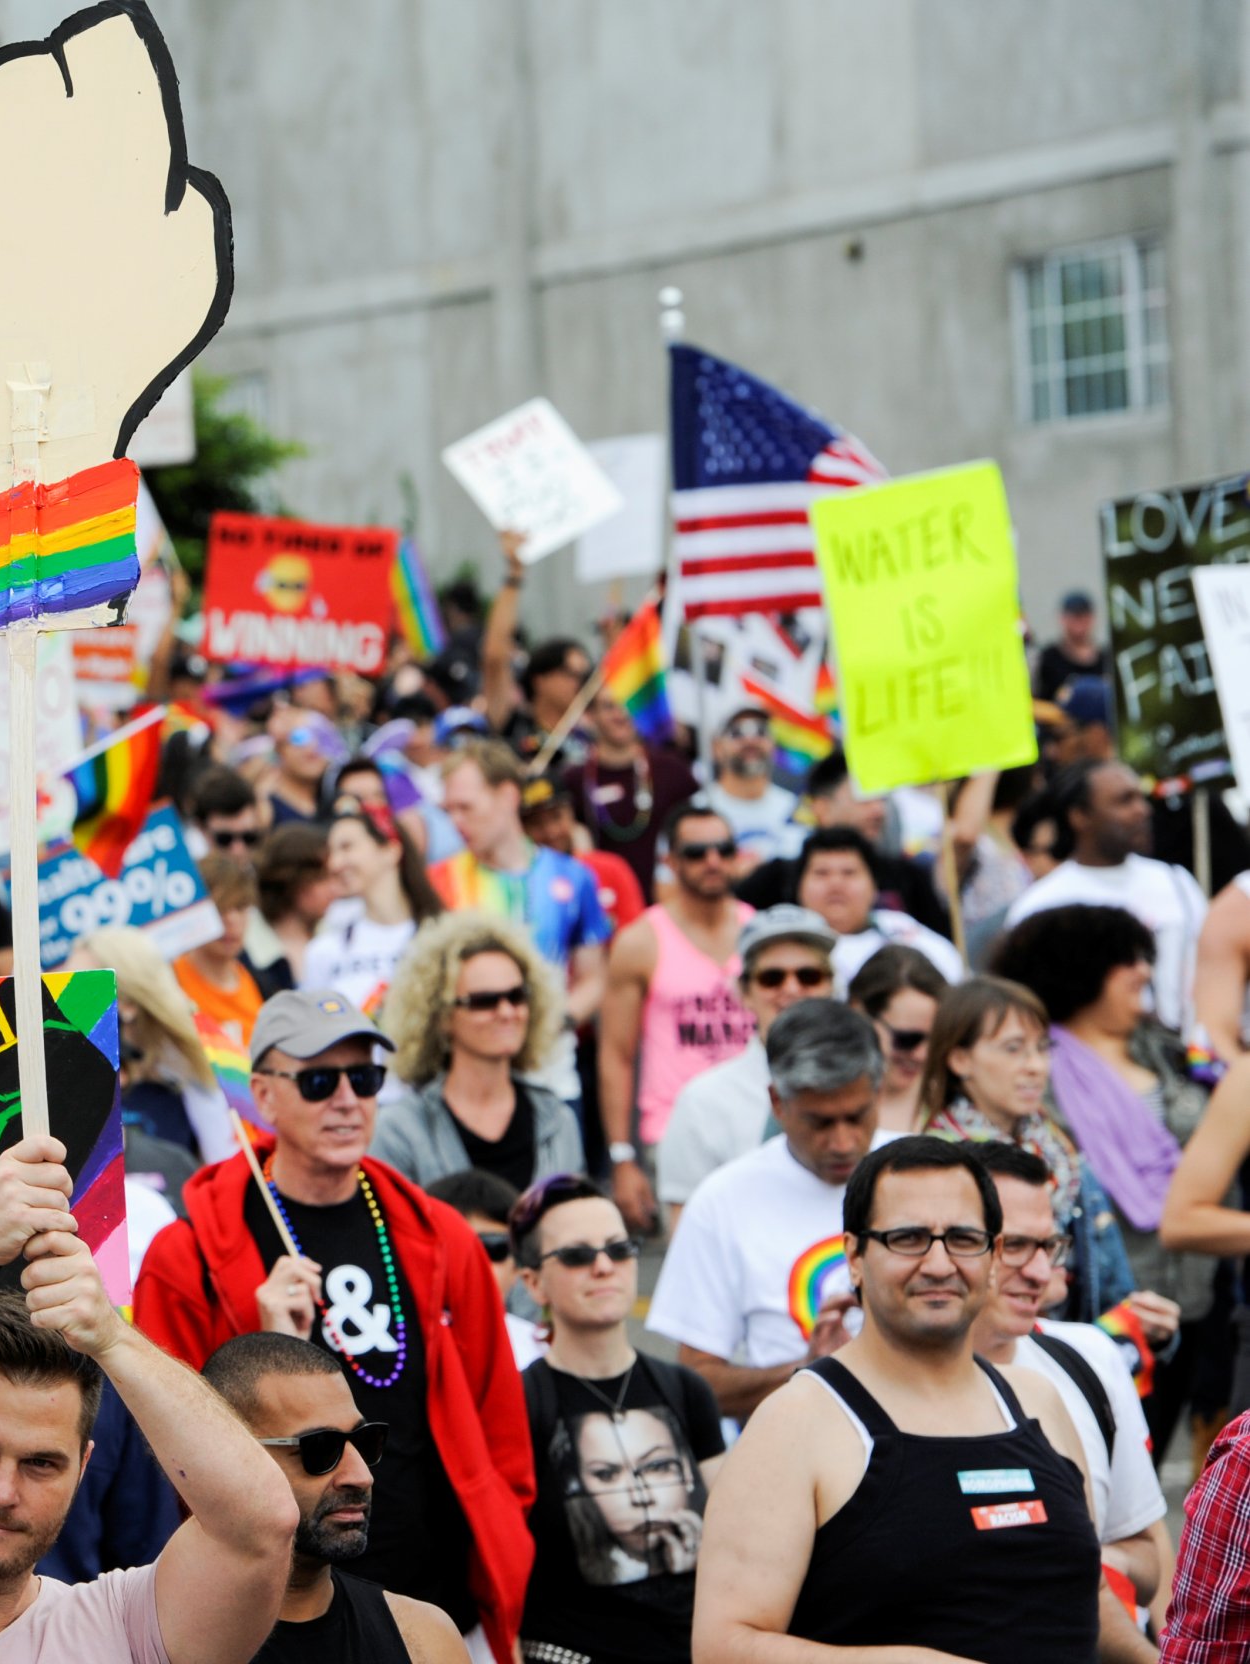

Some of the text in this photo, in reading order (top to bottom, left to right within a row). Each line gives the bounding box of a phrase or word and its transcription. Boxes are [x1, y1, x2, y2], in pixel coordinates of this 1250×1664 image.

[828, 501, 989, 587] WATER
[1103, 474, 1249, 558] LOVE
[209, 608, 385, 673] WINNING
[899, 594, 946, 652] IS
[59, 857, 197, 934] 99%
